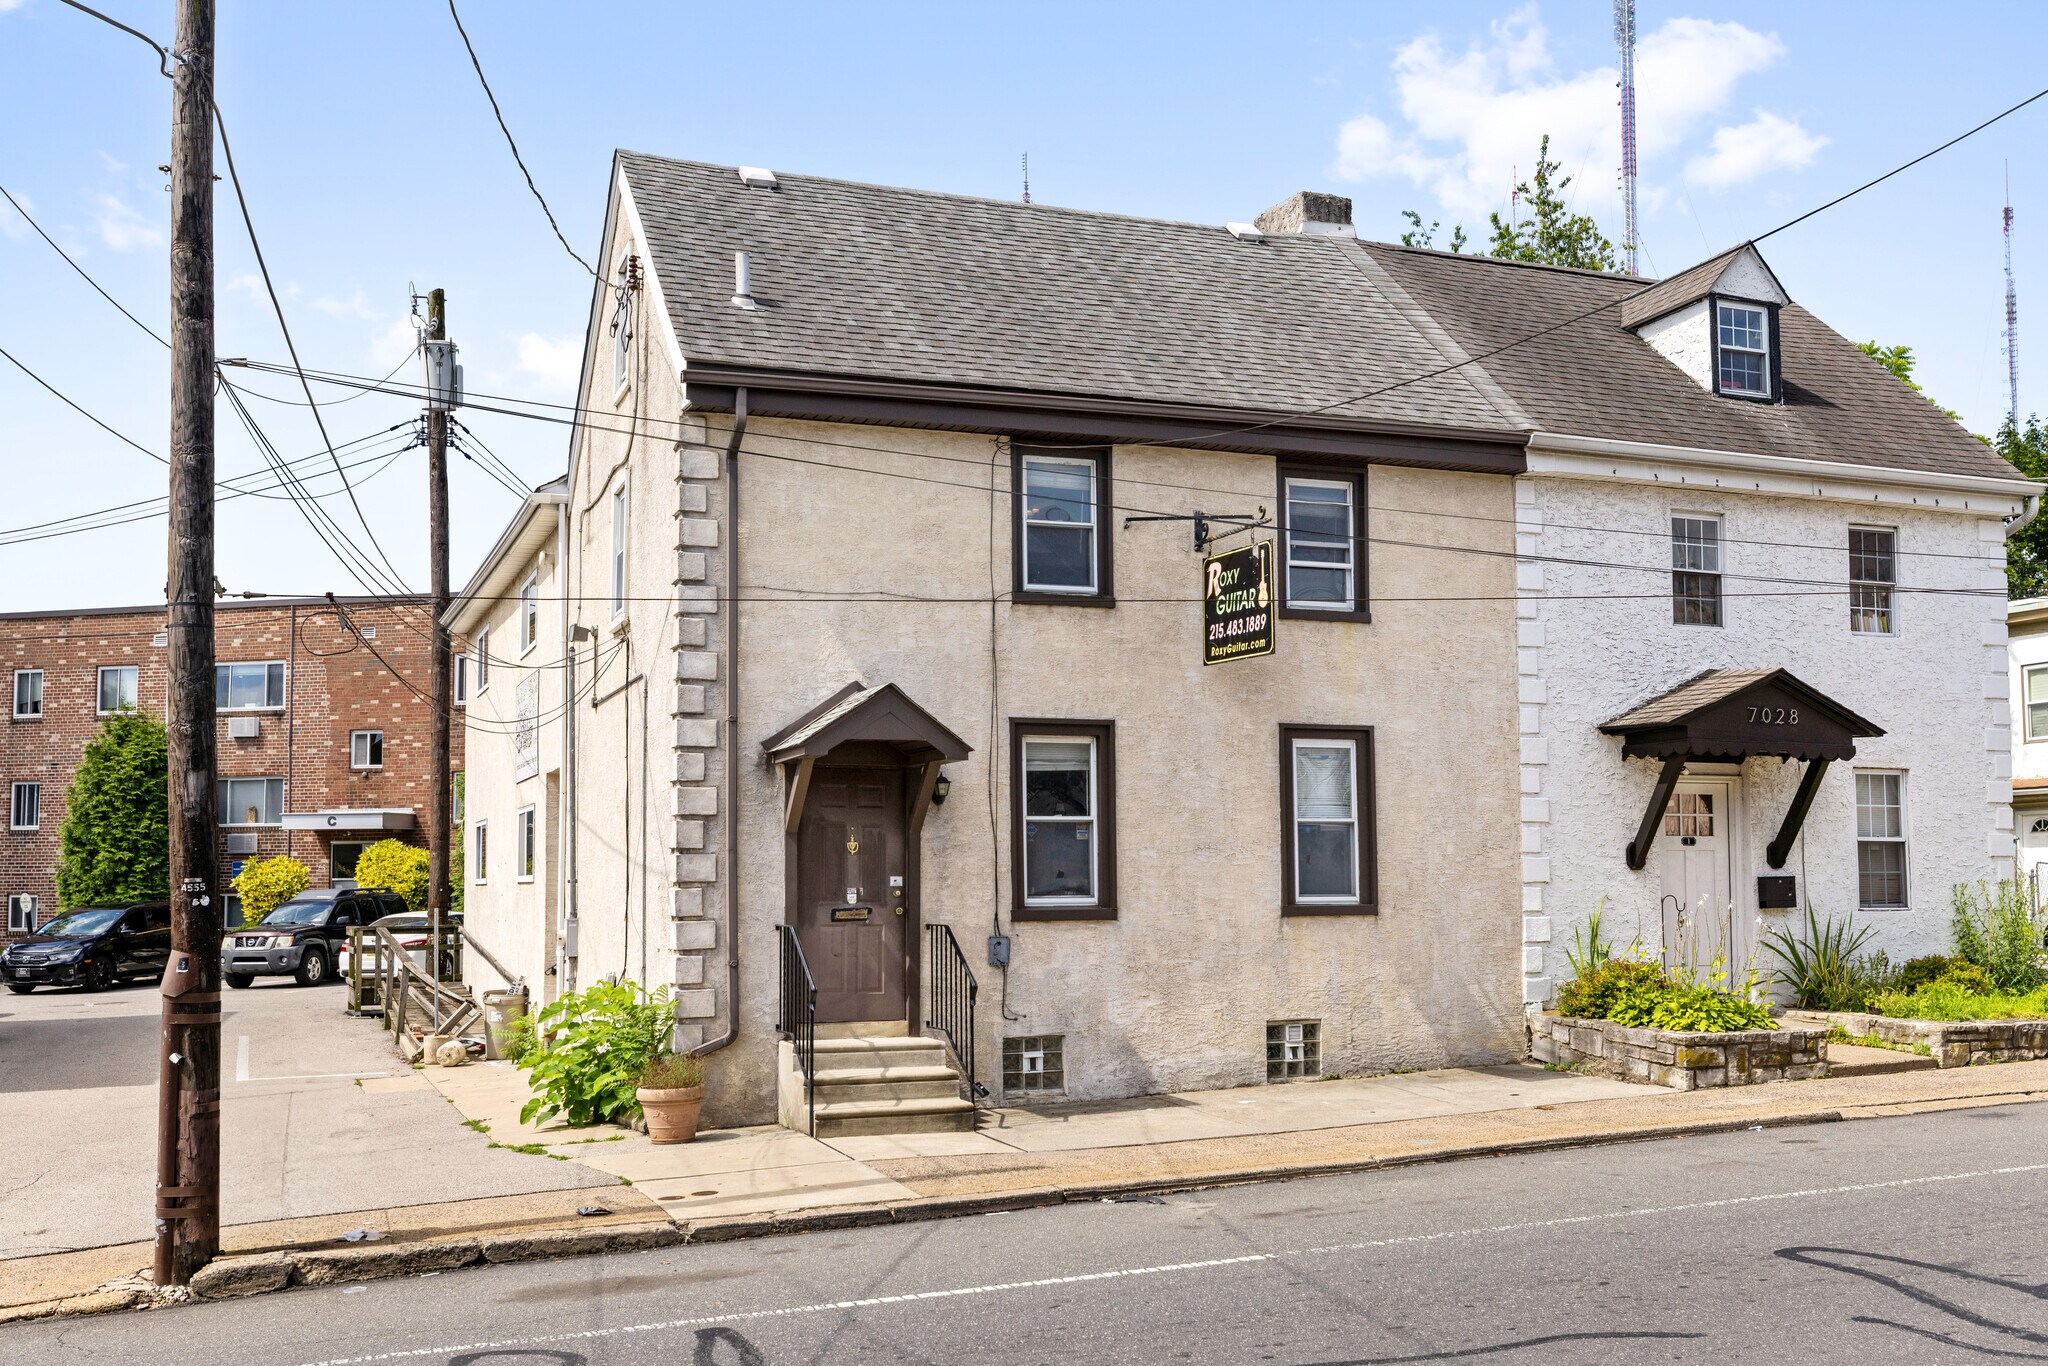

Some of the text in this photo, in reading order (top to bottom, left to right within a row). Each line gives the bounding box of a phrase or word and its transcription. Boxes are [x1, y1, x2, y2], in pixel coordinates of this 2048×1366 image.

[1216, 588, 1256, 615] GUITAR
[1209, 613, 1267, 640] 215.483.1889
[1211, 638, 1266, 657] RoxyGuitar.com
[1747, 706, 1799, 725] 7028
[327, 816, 337, 827] C
[181, 882, 206, 892] 4555
